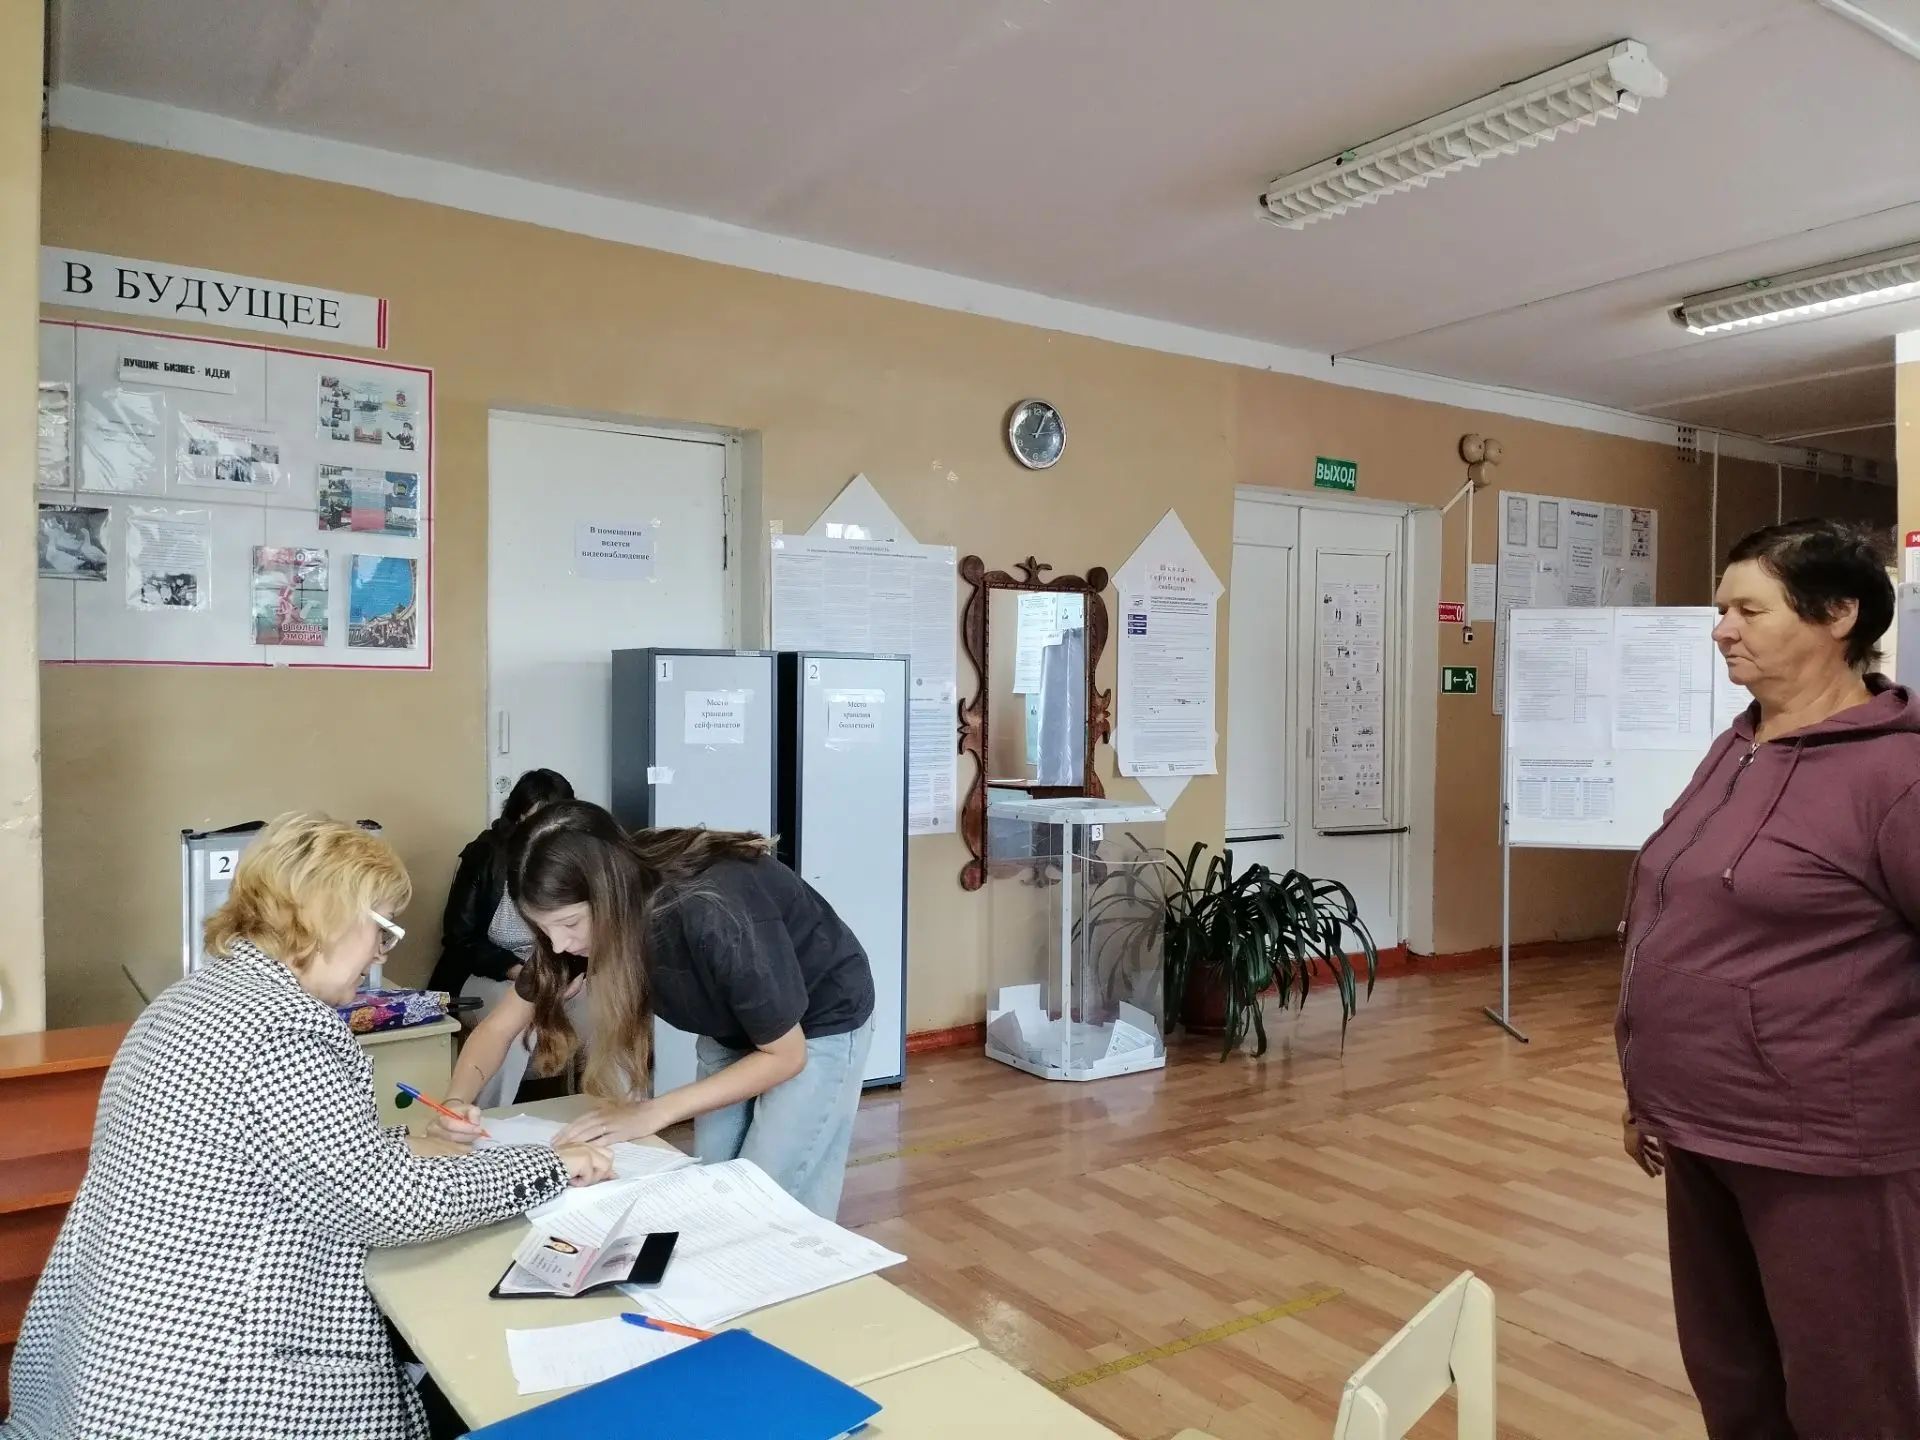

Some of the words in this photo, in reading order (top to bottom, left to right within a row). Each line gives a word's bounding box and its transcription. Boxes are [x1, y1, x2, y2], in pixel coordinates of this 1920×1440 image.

[63, 261, 93, 294] В
[115, 267, 341, 330] БУДУЩЕЕ
[123, 358, 160, 370] ЛУЧШИЕ
[164, 362, 196, 375] БИЗНЕС
[204, 367, 231, 380] ИДЕИ
[1033, 407, 1042, 416] 12
[1316, 462, 1356, 487] ВЫХОД
[590, 526, 596, 534] В
[581, 550, 650, 561] видеонаблюдение
[662, 662, 668, 678] 1
[809, 664, 818, 680] 2
[706, 698, 729, 707] Место
[694, 721, 742, 731] сейф-пакетов
[1096, 827, 1102, 839] 3
[218, 856, 231, 873] 2
